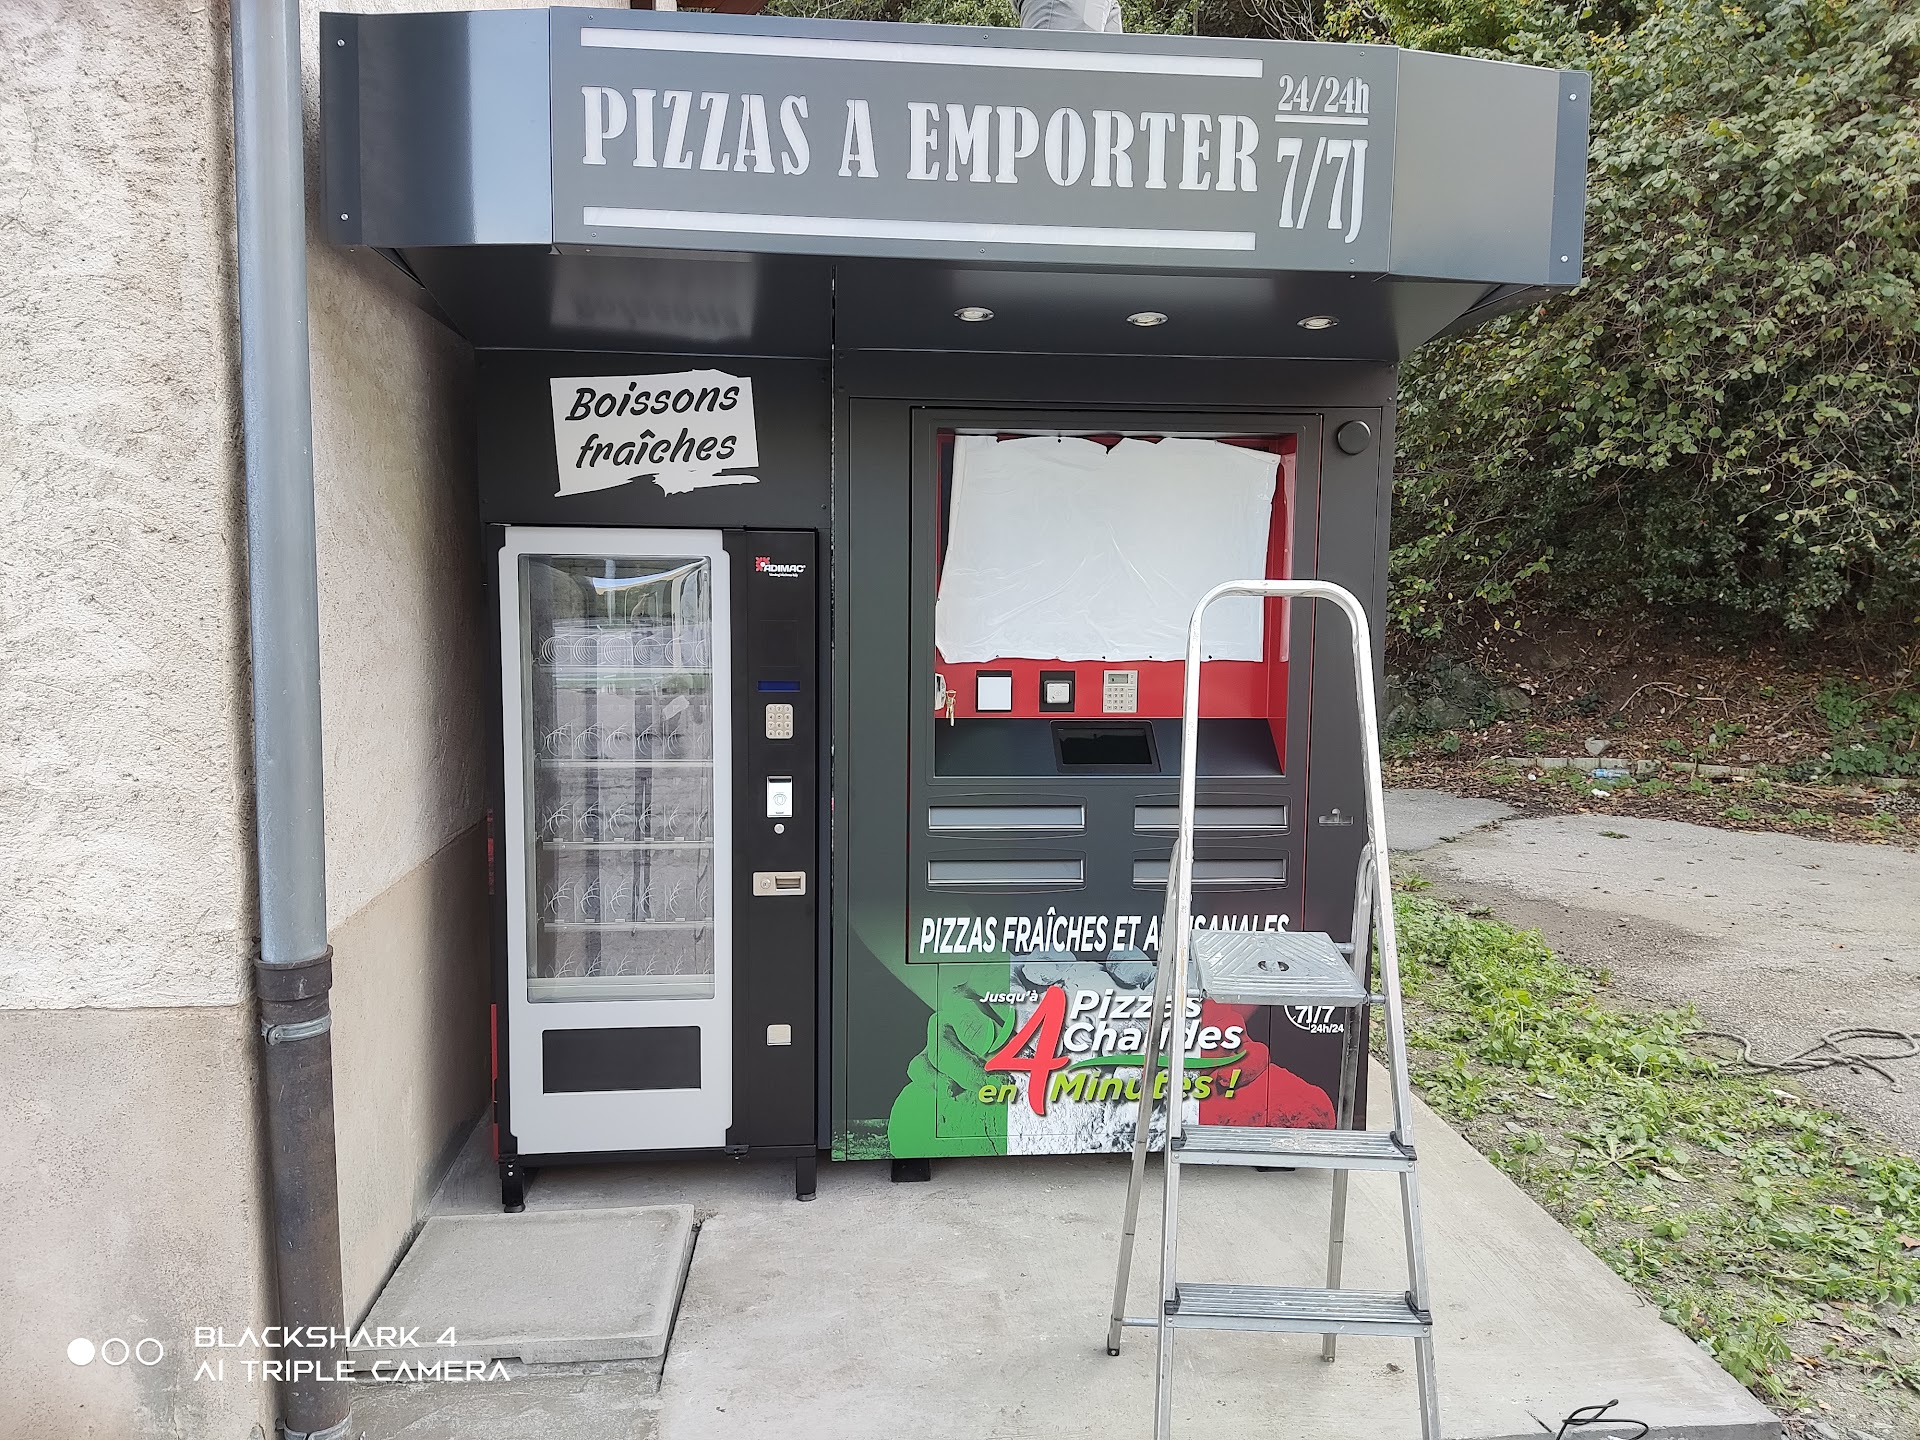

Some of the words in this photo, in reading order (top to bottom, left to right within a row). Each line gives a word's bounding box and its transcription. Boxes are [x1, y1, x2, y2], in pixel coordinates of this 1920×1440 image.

[1277, 73, 1370, 114] 24/24h
[580, 84, 809, 177] PIZZAS
[838, 98, 880, 179] A
[906, 101, 1259, 193] EMPORTER
[1276, 136, 1369, 244] 7/7J
[564, 381, 741, 422] Boissons
[575, 427, 738, 469] fraîches
[918, 915, 999, 954] PIZZAS
[1001, 906, 1109, 953] FRAÎCHES
[1112, 915, 1142, 952] ET
[979, 989, 1039, 1004] Jusqu'à
[1310, 1023, 1345, 1034] 24h/24
[984, 985, 1070, 1116] 4
[978, 1083, 1018, 1103] en
